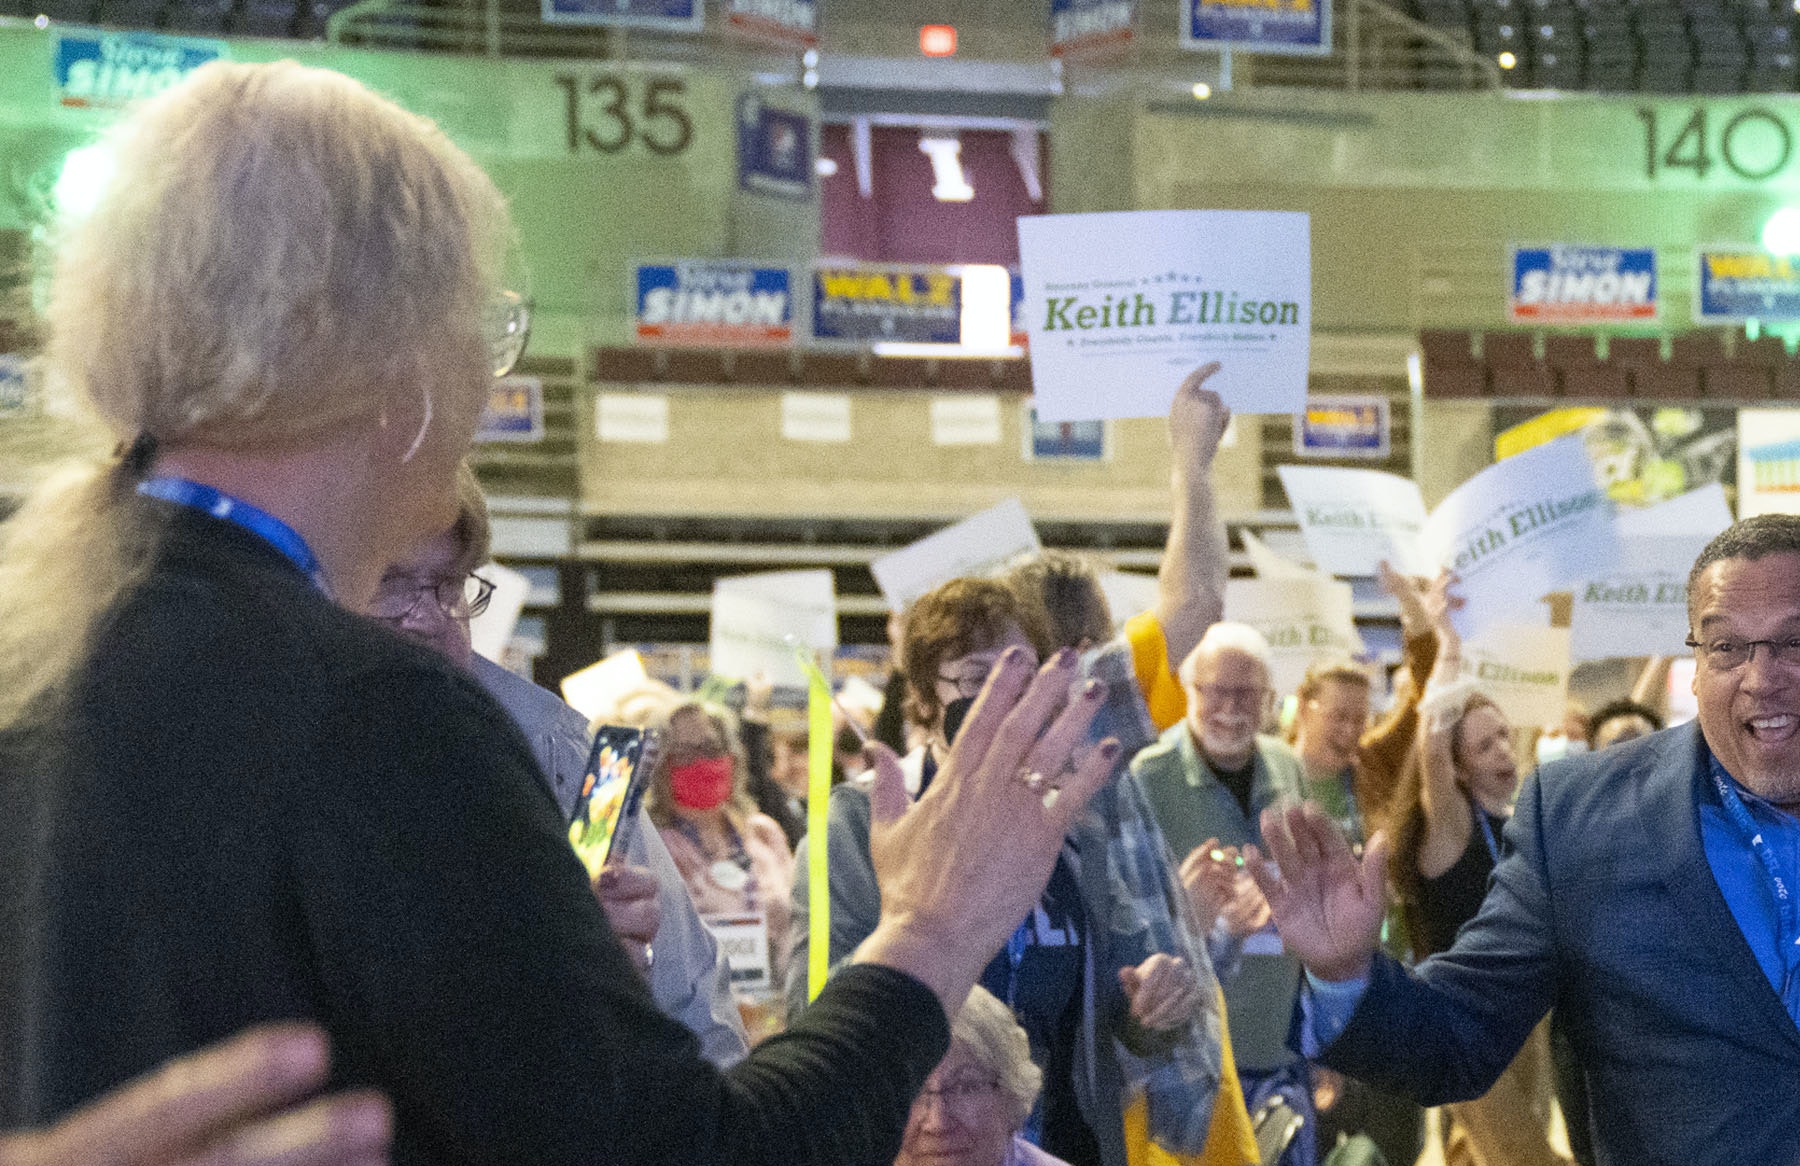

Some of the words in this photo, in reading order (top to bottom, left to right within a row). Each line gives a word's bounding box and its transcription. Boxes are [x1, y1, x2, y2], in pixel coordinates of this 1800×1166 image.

[68, 59, 188, 96] SIMO
[554, 73, 693, 154] 135
[1636, 104, 1793, 181] 140
[822, 266, 954, 303] WALZ
[1519, 270, 1652, 304] SIMON
[643, 286, 786, 324] SIMON
[1043, 293, 1156, 332] Keith
[1166, 290, 1300, 326] Ellison
[1455, 526, 1505, 569] eith
[1508, 488, 1606, 538] Ellison
[1583, 581, 1649, 603] Keith
[1773, 876, 1790, 900] vote
